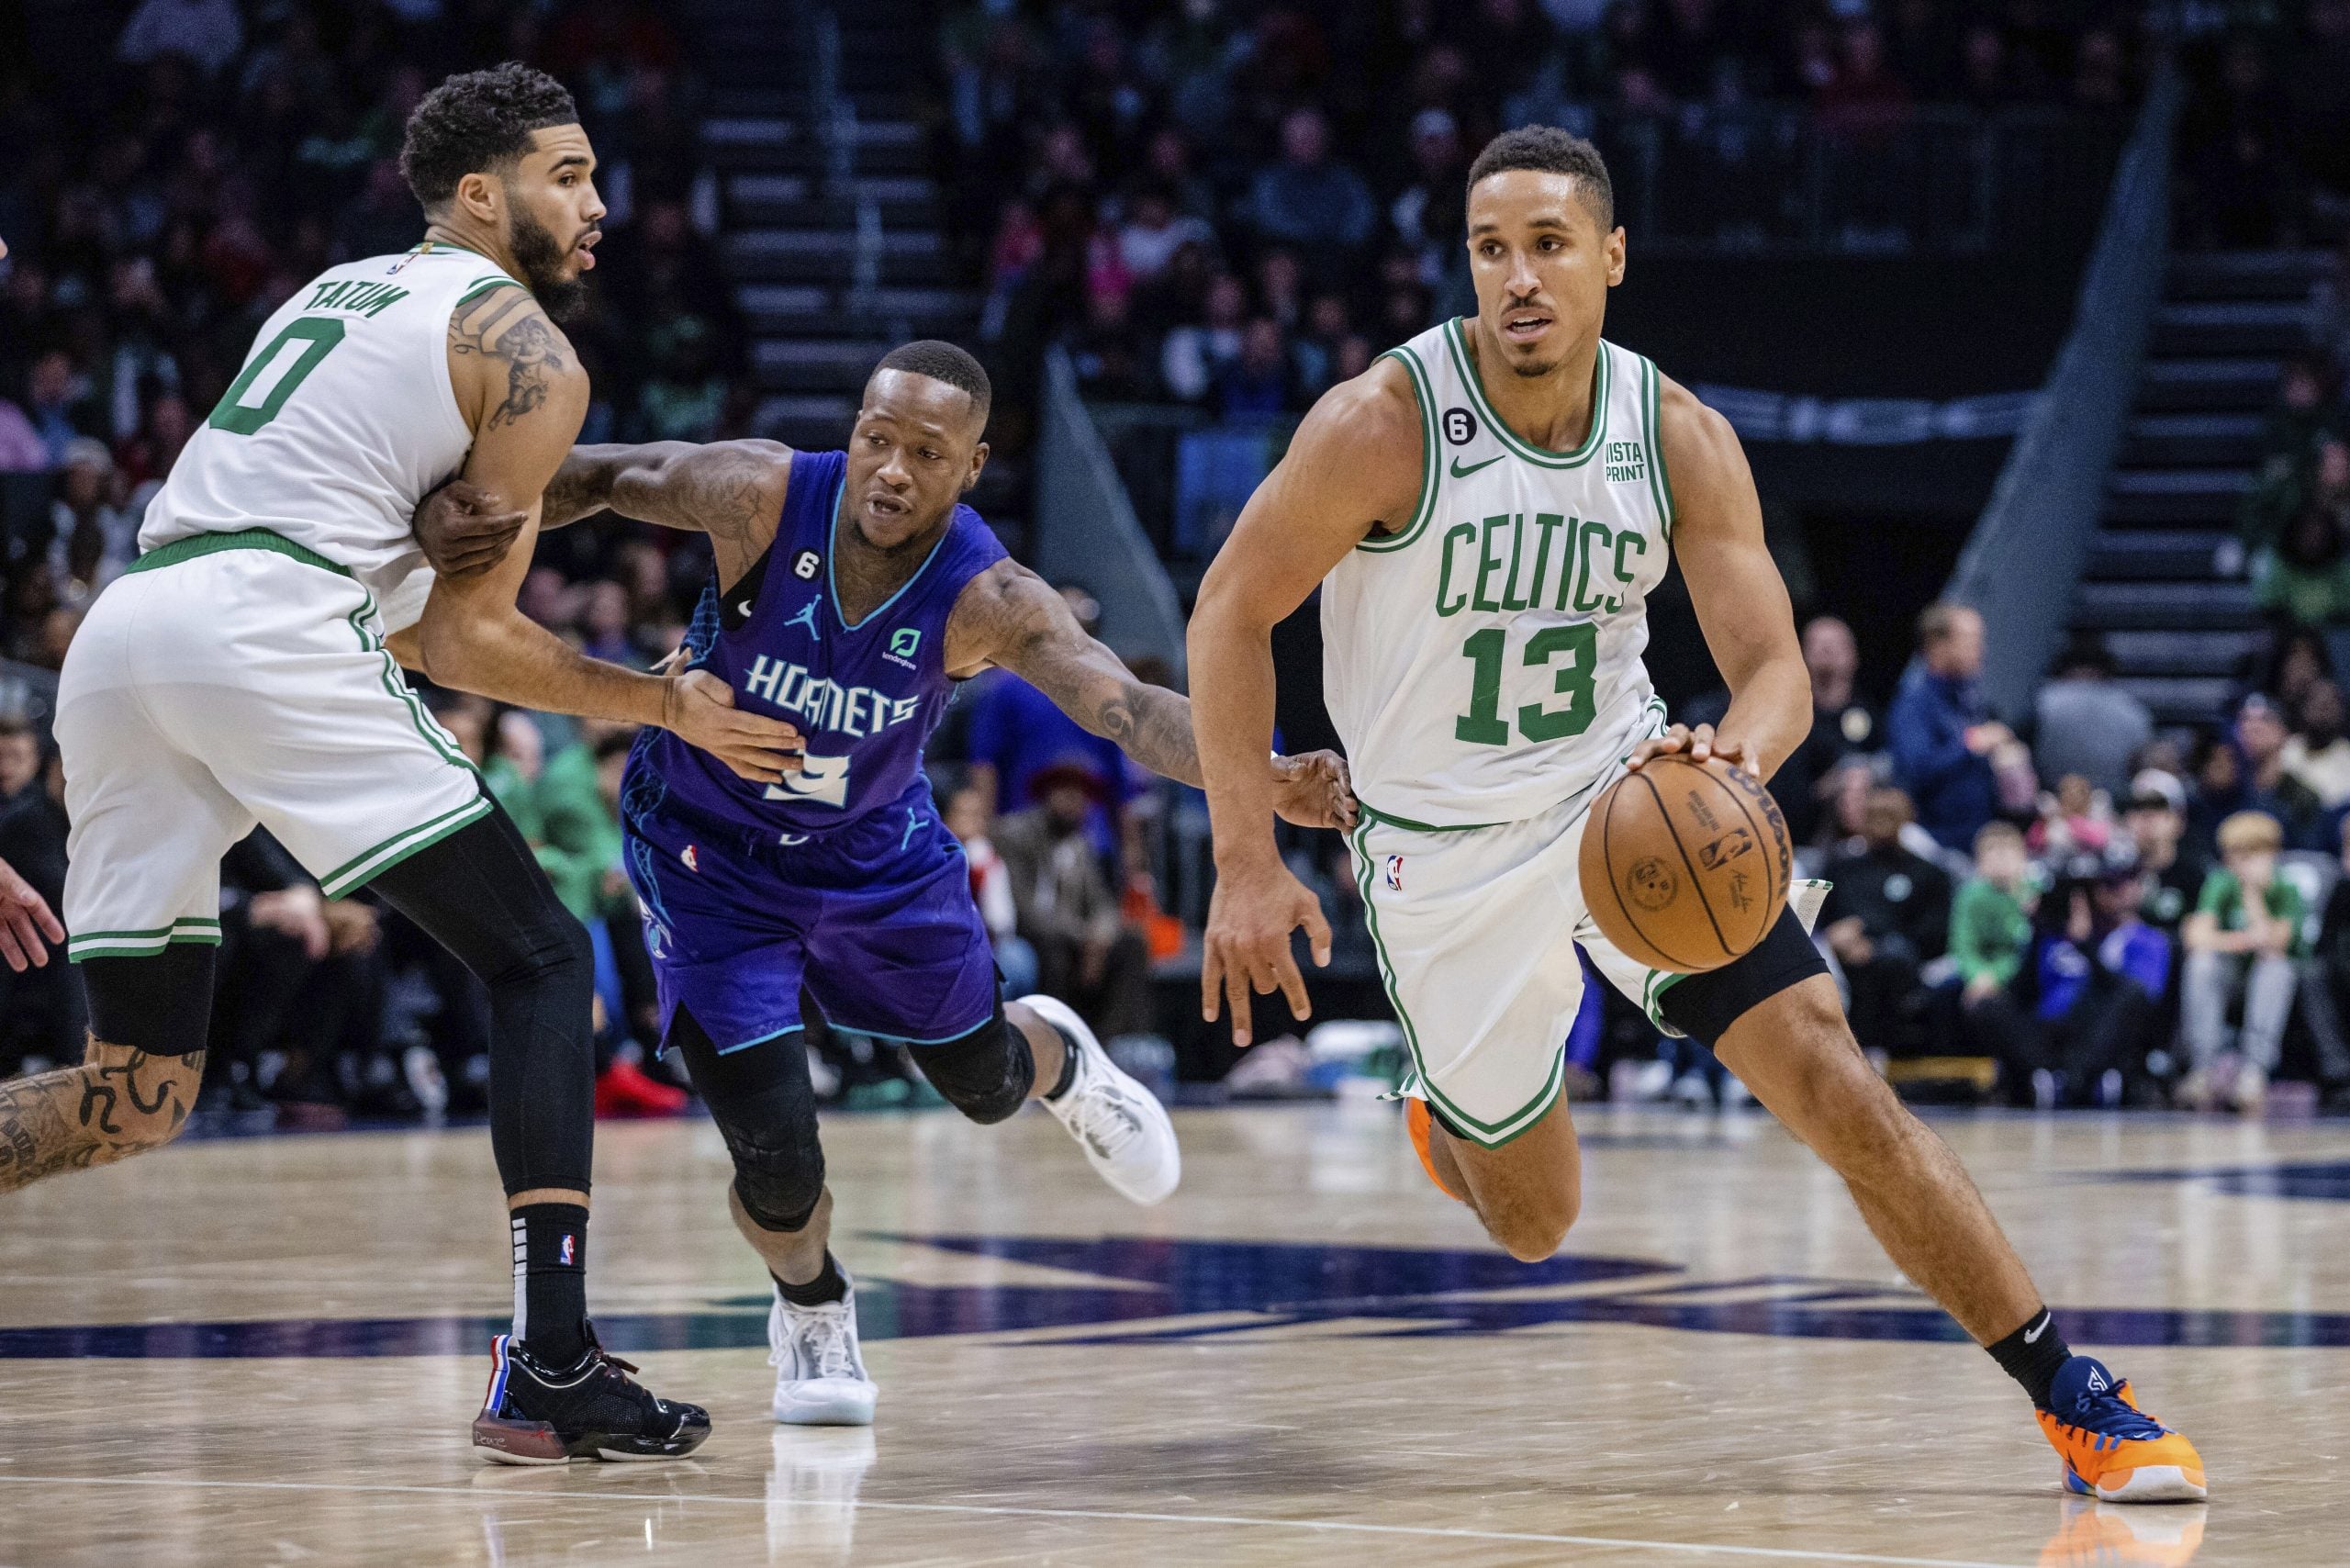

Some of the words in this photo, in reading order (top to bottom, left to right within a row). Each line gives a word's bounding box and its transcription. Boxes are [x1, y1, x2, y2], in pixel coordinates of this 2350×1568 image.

[303, 281, 410, 318] TATUM
[209, 317, 345, 436] 0
[1448, 413, 1468, 442] 6
[1606, 464, 1645, 482] PRINT
[794, 551, 820, 580] 6
[1436, 513, 1646, 618] CELTICS
[881, 651, 917, 671] lendingtree
[744, 653, 923, 738] HORNETS
[1455, 622, 1598, 746] 13
